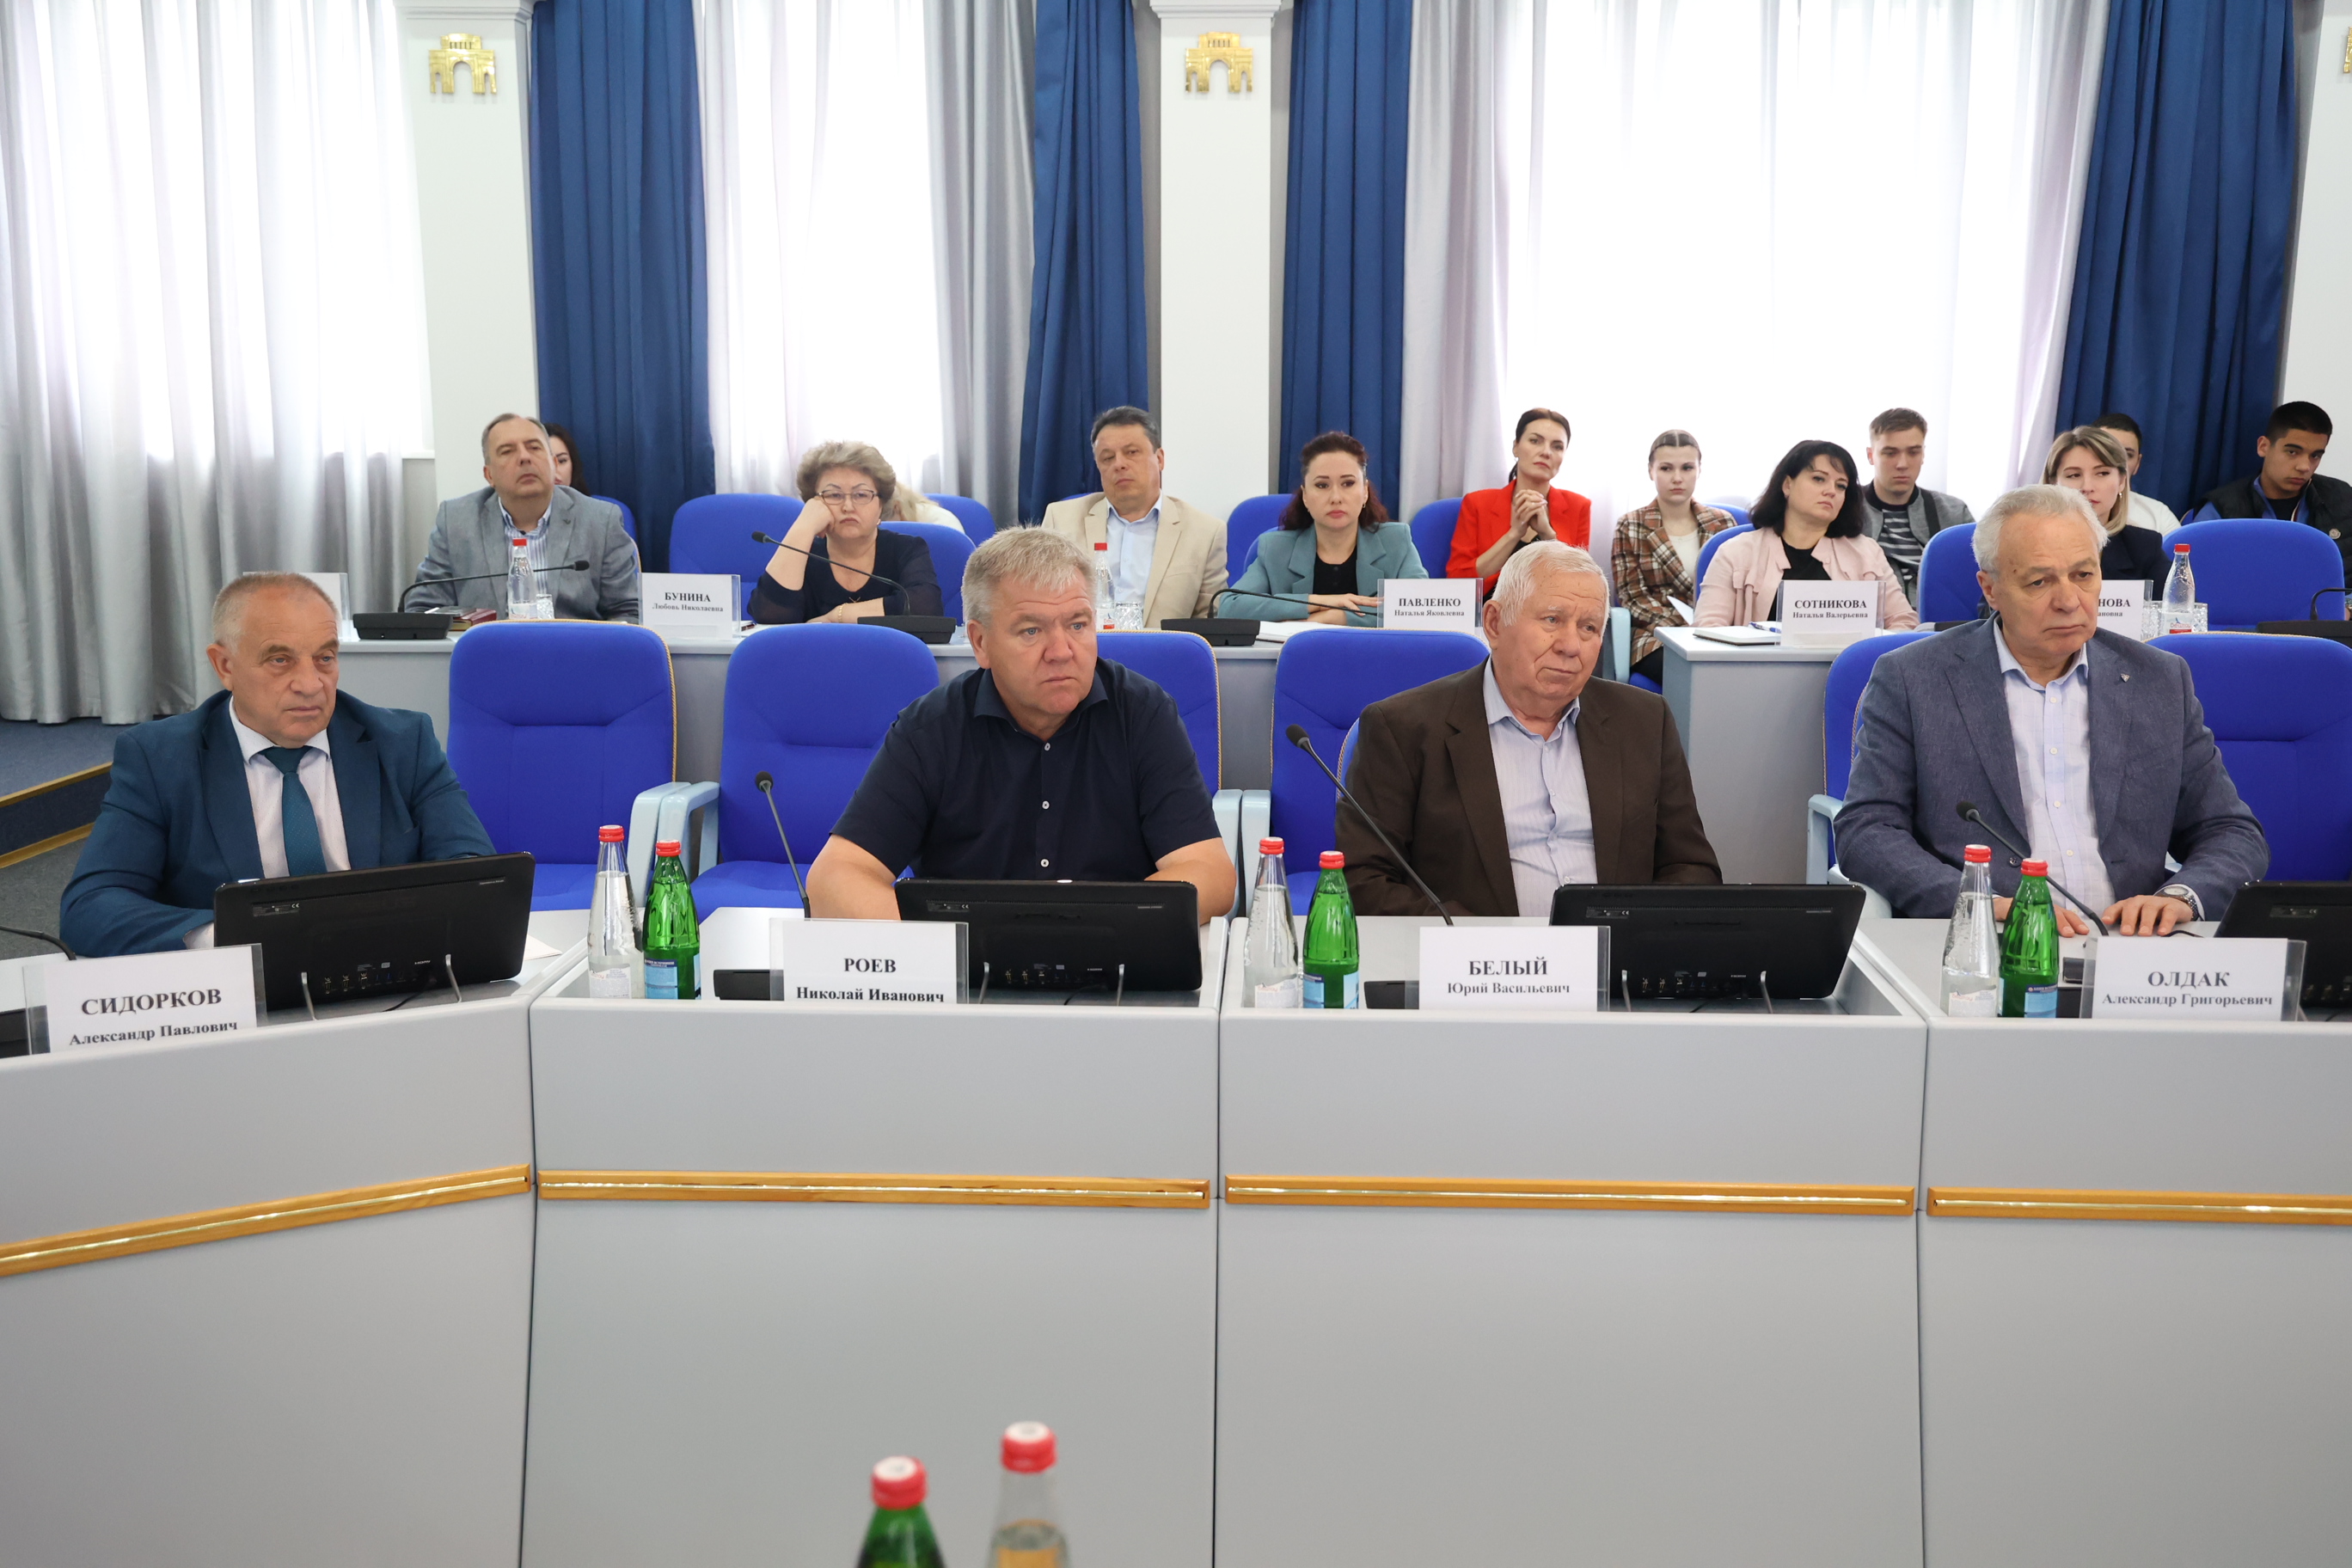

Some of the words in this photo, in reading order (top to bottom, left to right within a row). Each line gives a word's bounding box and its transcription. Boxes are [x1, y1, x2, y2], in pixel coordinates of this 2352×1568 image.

[665, 591, 711, 603] БУНИНА
[1399, 597, 1461, 607] ПАВЛЕНКО
[1794, 599, 1867, 609] СОТНИКОВА
[2098, 598, 2131, 608] НОВА
[682, 603, 724, 612] Николаевна
[1826, 611, 1868, 620] Валерьевна
[844, 958, 897, 973] РОЕВ
[1468, 956, 1548, 976] БЕЛЫЙ
[2147, 971, 2230, 989] ОЛДАК
[796, 986, 864, 1001] Николай
[868, 989, 944, 1002] Иванович
[1448, 982, 1488, 996] Юрий
[1492, 983, 1570, 994] Васильевич
[81, 989, 222, 1016] СИДОРКОВ
[2102, 993, 2177, 1008] Александр
[2181, 993, 2273, 1008] Григорьевич
[69, 1029, 156, 1046] Александр
[160, 1021, 238, 1038] Павлович
